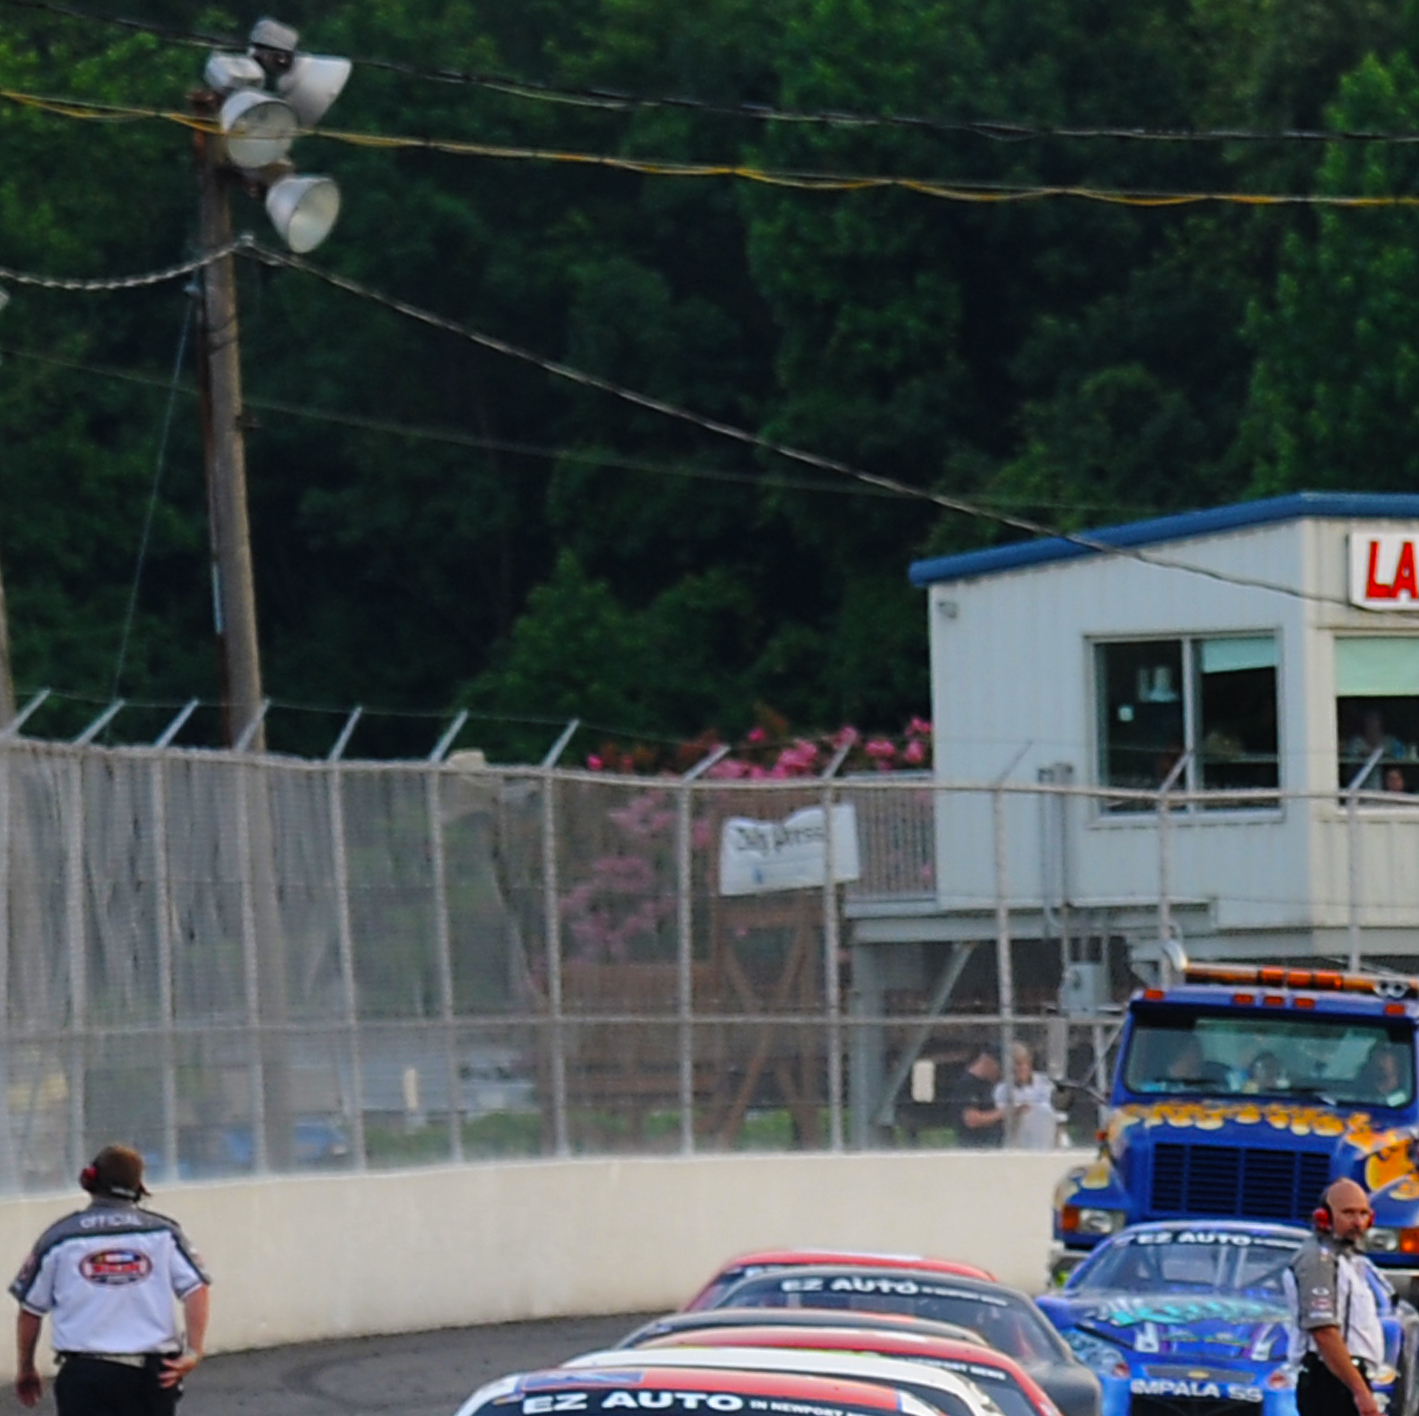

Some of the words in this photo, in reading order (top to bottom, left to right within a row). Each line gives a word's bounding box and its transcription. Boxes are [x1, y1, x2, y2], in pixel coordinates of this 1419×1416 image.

[80, 1214, 142, 1229] OFFICIAL
[1138, 1234, 1171, 1244] EZ
[1178, 1232, 1249, 1245] AUTO
[781, 1278, 823, 1291] EZ
[831, 1275, 919, 1294] AUTO
[1130, 1379, 1220, 1398] IMPALA
[1228, 1387, 1264, 1402] SS
[523, 1393, 588, 1415] EZ
[602, 1391, 742, 1411] AUTO
[751, 1402, 760, 1410] IN
